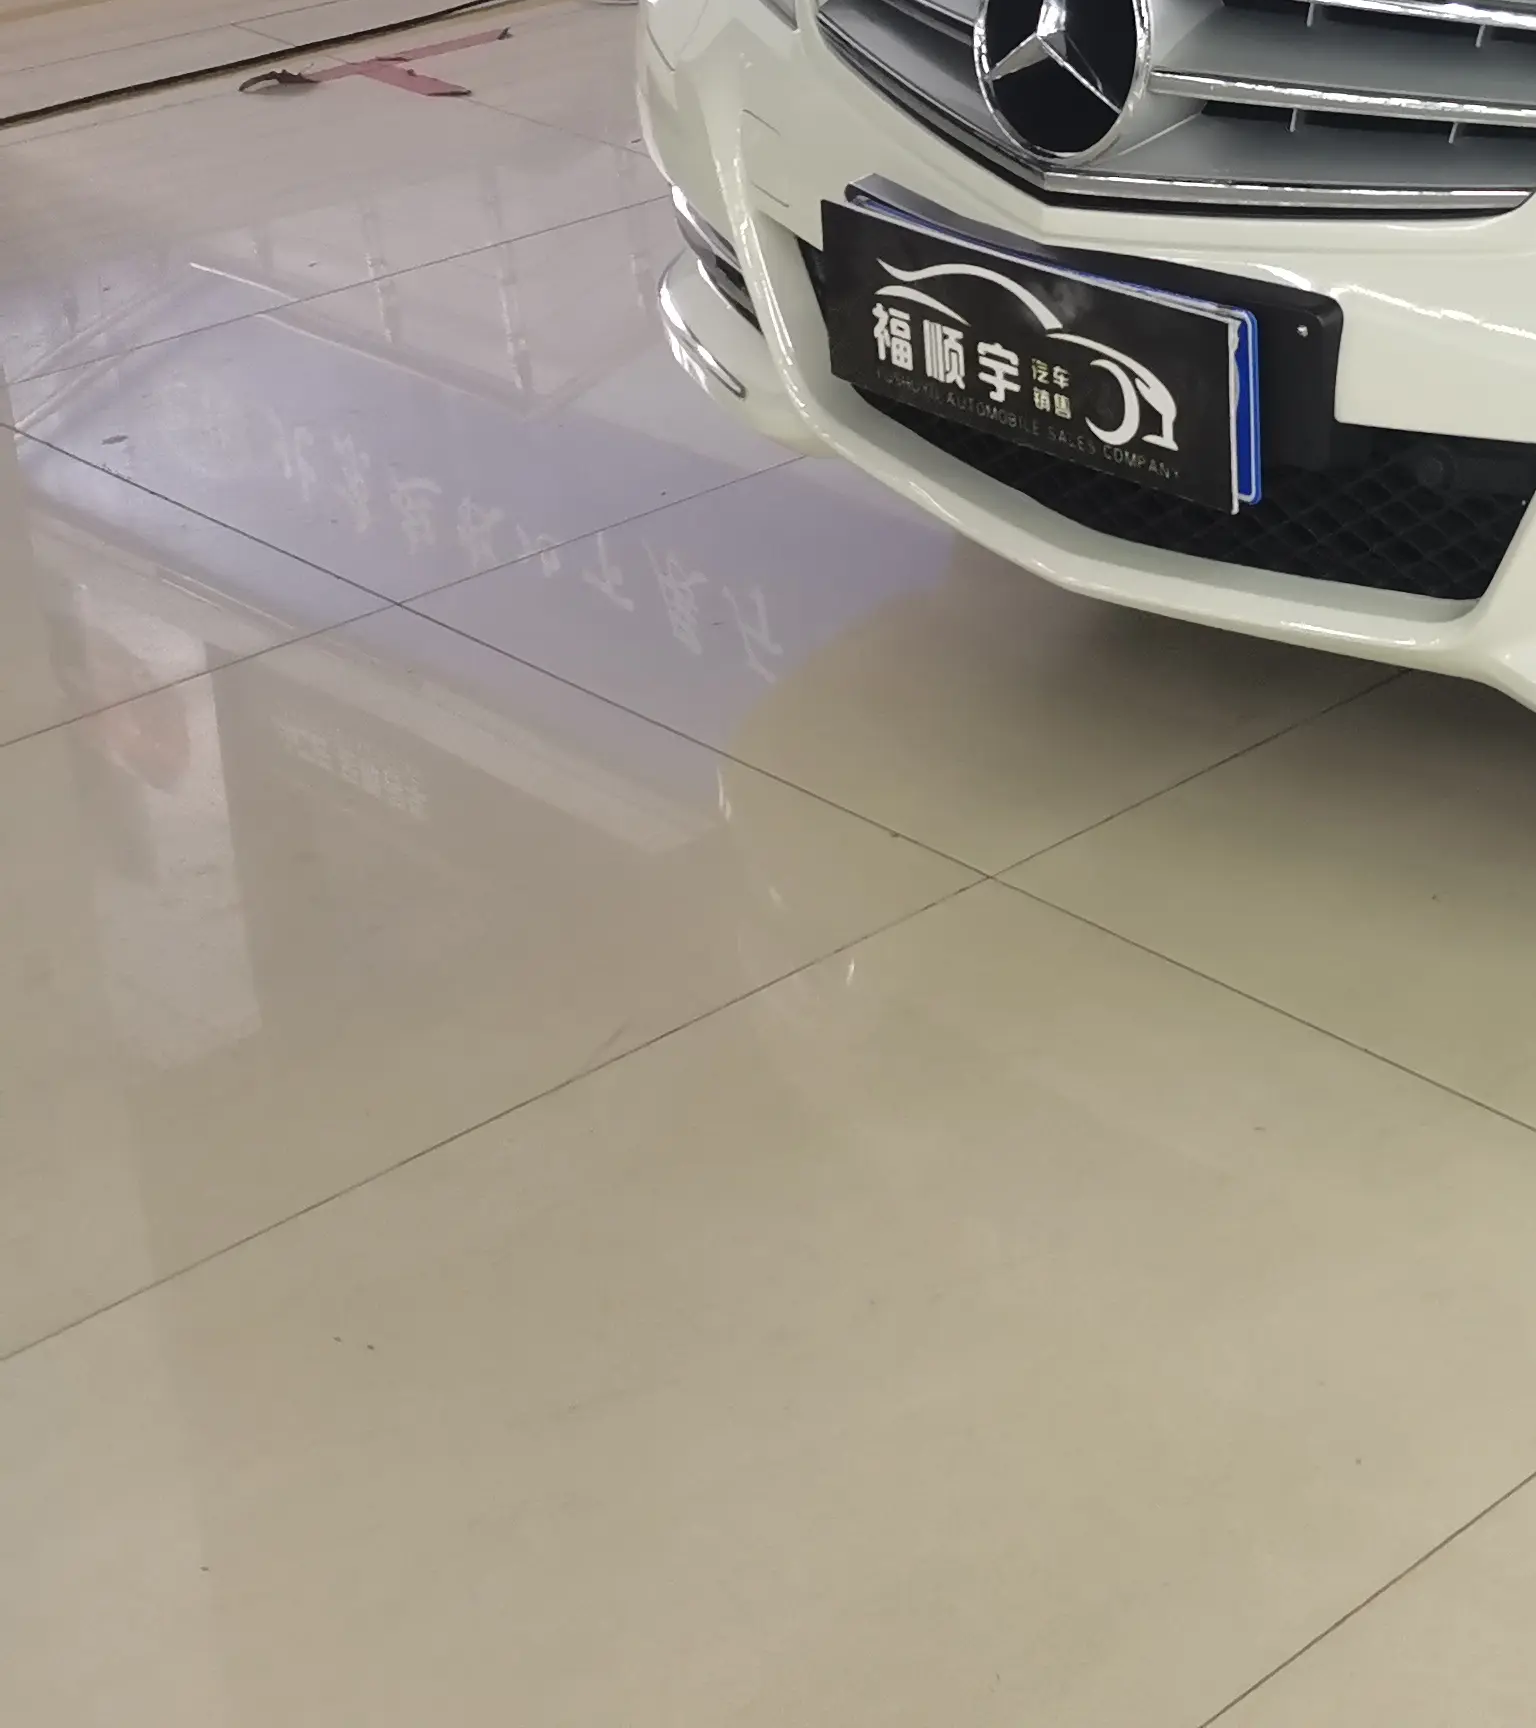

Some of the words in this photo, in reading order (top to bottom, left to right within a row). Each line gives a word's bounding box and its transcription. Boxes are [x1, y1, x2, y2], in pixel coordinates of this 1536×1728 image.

[872, 301, 1022, 403] 福顺宇
[1031, 358, 1071, 389] 汽车
[1032, 387, 1073, 419] 销售
[947, 391, 1040, 436] AUTOMOBILE
[1103, 445, 1180, 480] COMPANY
